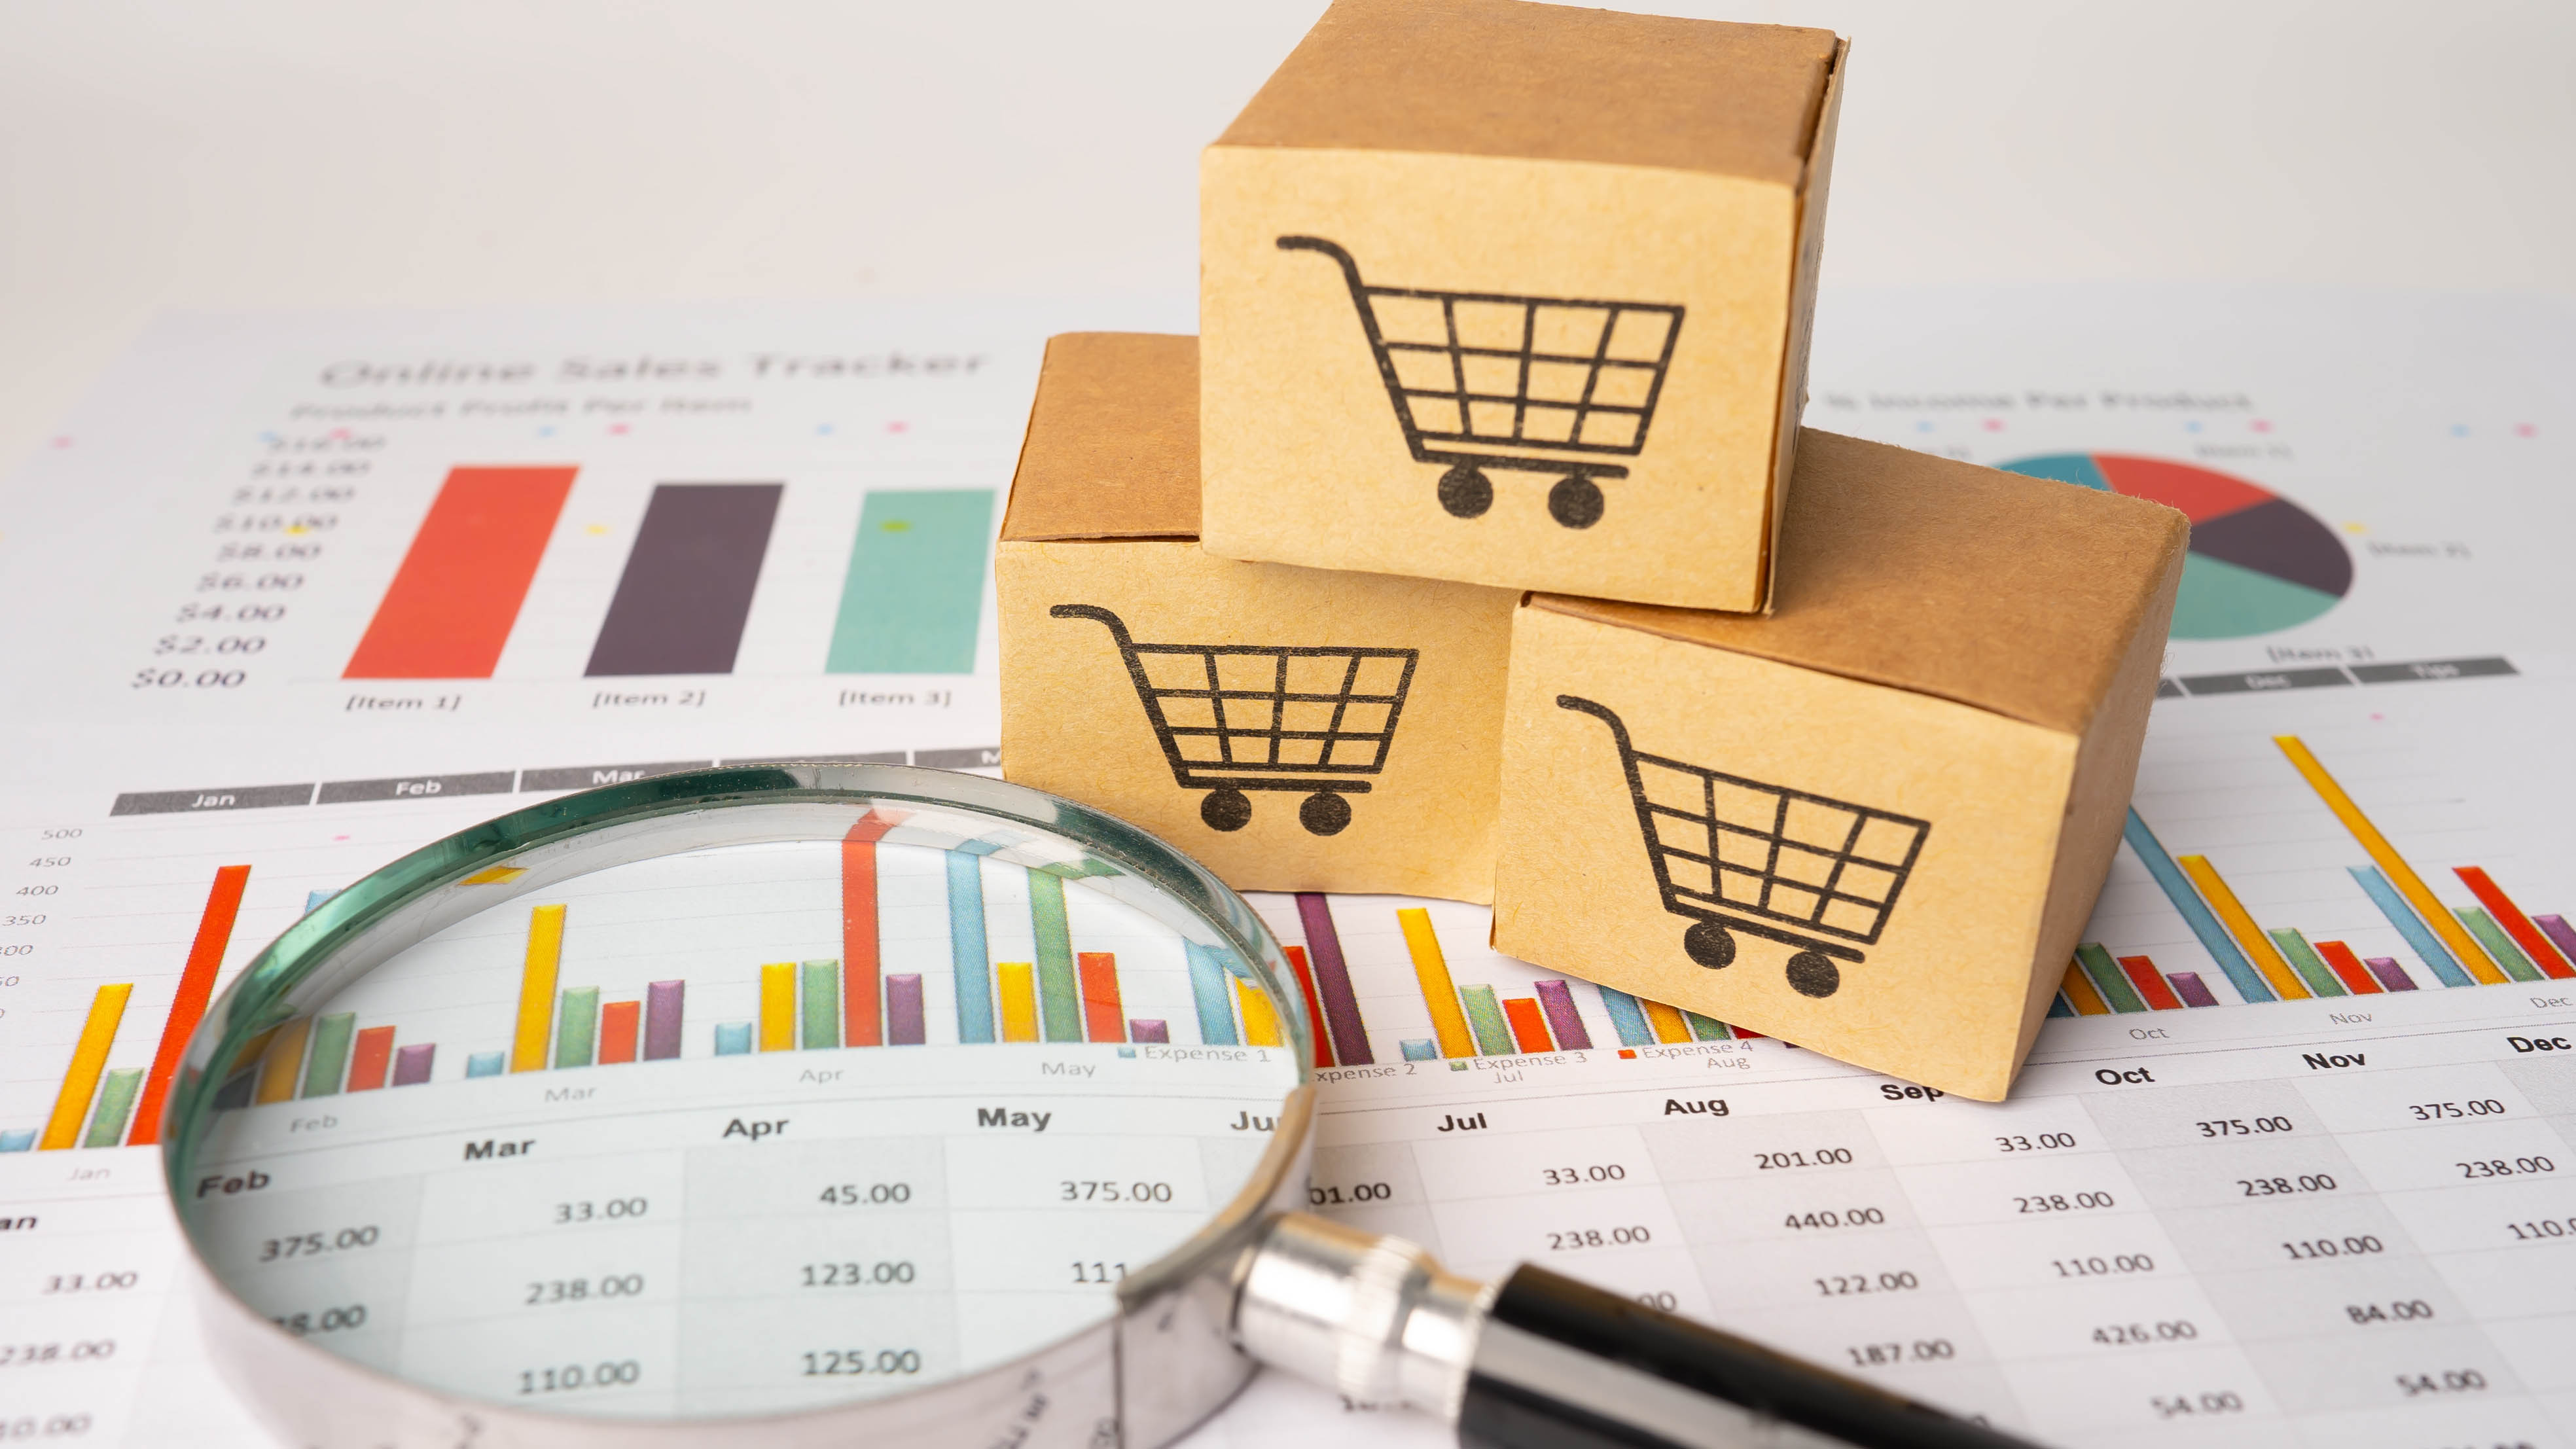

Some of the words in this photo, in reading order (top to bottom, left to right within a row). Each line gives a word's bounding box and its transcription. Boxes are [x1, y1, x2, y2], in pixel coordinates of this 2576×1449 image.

[320, 357, 535, 389] Online
[560, 354, 722, 381] Sales
[752, 351, 987, 378] Tracker
[196, 571, 305, 593] $6.00
[176, 602, 287, 623] $4.00
[154, 634, 267, 656] $2.00
[131, 668, 246, 689] $0.00
[345, 694, 423, 712] [Item
[433, 694, 462, 711] 1]
[592, 690, 669, 709] [Item
[677, 689, 706, 707] 2]
[838, 690, 914, 708] [Item
[922, 689, 952, 707] 3]
[192, 793, 236, 809] Jan
[396, 779, 442, 796] Feb
[41, 828, 83, 840] 500
[29, 856, 71, 868] 450
[16, 885, 59, 897] 400
[2, 914, 46, 926] 350
[2530, 995, 2575, 1009] Dec
[2329, 1011, 2373, 1025] Nov
[2128, 1026, 2171, 1042] Oct
[1145, 1046, 1248, 1062] Expense
[1261, 1048, 1272, 1063] 1
[1642, 1041, 1732, 1060] Expense
[1740, 1040, 1753, 1052] 4
[1041, 1061, 1097, 1079] May
[1475, 1052, 1566, 1072] Expense
[1574, 1050, 1588, 1065] 3
[1706, 1054, 1751, 1070] Aug
[798, 1067, 846, 1084] Apr
[1312, 1064, 1398, 1084] xpense
[1406, 1063, 1418, 1077] 2
[1492, 1069, 1524, 1084] Jul
[544, 1084, 598, 1103] Mar
[0, 1215, 38, 1231] an
[196, 1169, 271, 1200] Feb
[464, 1137, 537, 1162] Mar
[723, 1118, 789, 1141] Apr
[976, 1107, 1052, 1132] May
[1230, 1111, 1281, 1132] Ju
[1437, 1112, 1488, 1132] Jul
[1663, 1097, 1730, 1117] Aug
[1880, 1083, 1944, 1102] Sep
[2095, 1065, 2156, 1086] Oct
[2301, 1051, 2367, 1071] Nov
[2507, 1035, 2573, 1053] Dec
[289, 1114, 339, 1134] Feb
[70, 1168, 111, 1182] Jan
[41, 1271, 139, 1295] 33.00
[259, 1225, 380, 1262] 375.00
[554, 1197, 649, 1224] 33.00
[818, 1182, 912, 1205] 45.00
[1060, 1180, 1173, 1203] 375.00
[1310, 1182, 1392, 1206] 01.00
[1543, 1163, 1626, 1187] 33.00
[1754, 1147, 1853, 1170] 201.00
[1994, 1132, 2077, 1153] 33.00
[2196, 1115, 2293, 1137] 375.00
[2408, 1098, 2506, 1121] 375.00
[524, 1272, 645, 1307] 238.00
[800, 1261, 916, 1287] 123.00
[1546, 1225, 1651, 1251] 238.00
[1784, 1207, 1885, 1230] 440.00
[2012, 1190, 2115, 1215] 238.00
[2236, 1173, 2338, 1197] 238.00
[2456, 1155, 2556, 1179] 238.00
[517, 1359, 641, 1396] 110.00
[801, 1348, 922, 1376] 125.00
[1814, 1270, 1919, 1297] 122.00
[2050, 1253, 2155, 1278] 110.00
[2281, 1234, 2384, 1261] 110.00
[1846, 1338, 1955, 1368] 187.00
[2092, 1320, 2198, 1346] 426.00
[2346, 1298, 2435, 1326] 84.00
[2149, 1389, 2244, 1420] 54.00
[2395, 1368, 2488, 1397] 54.00
